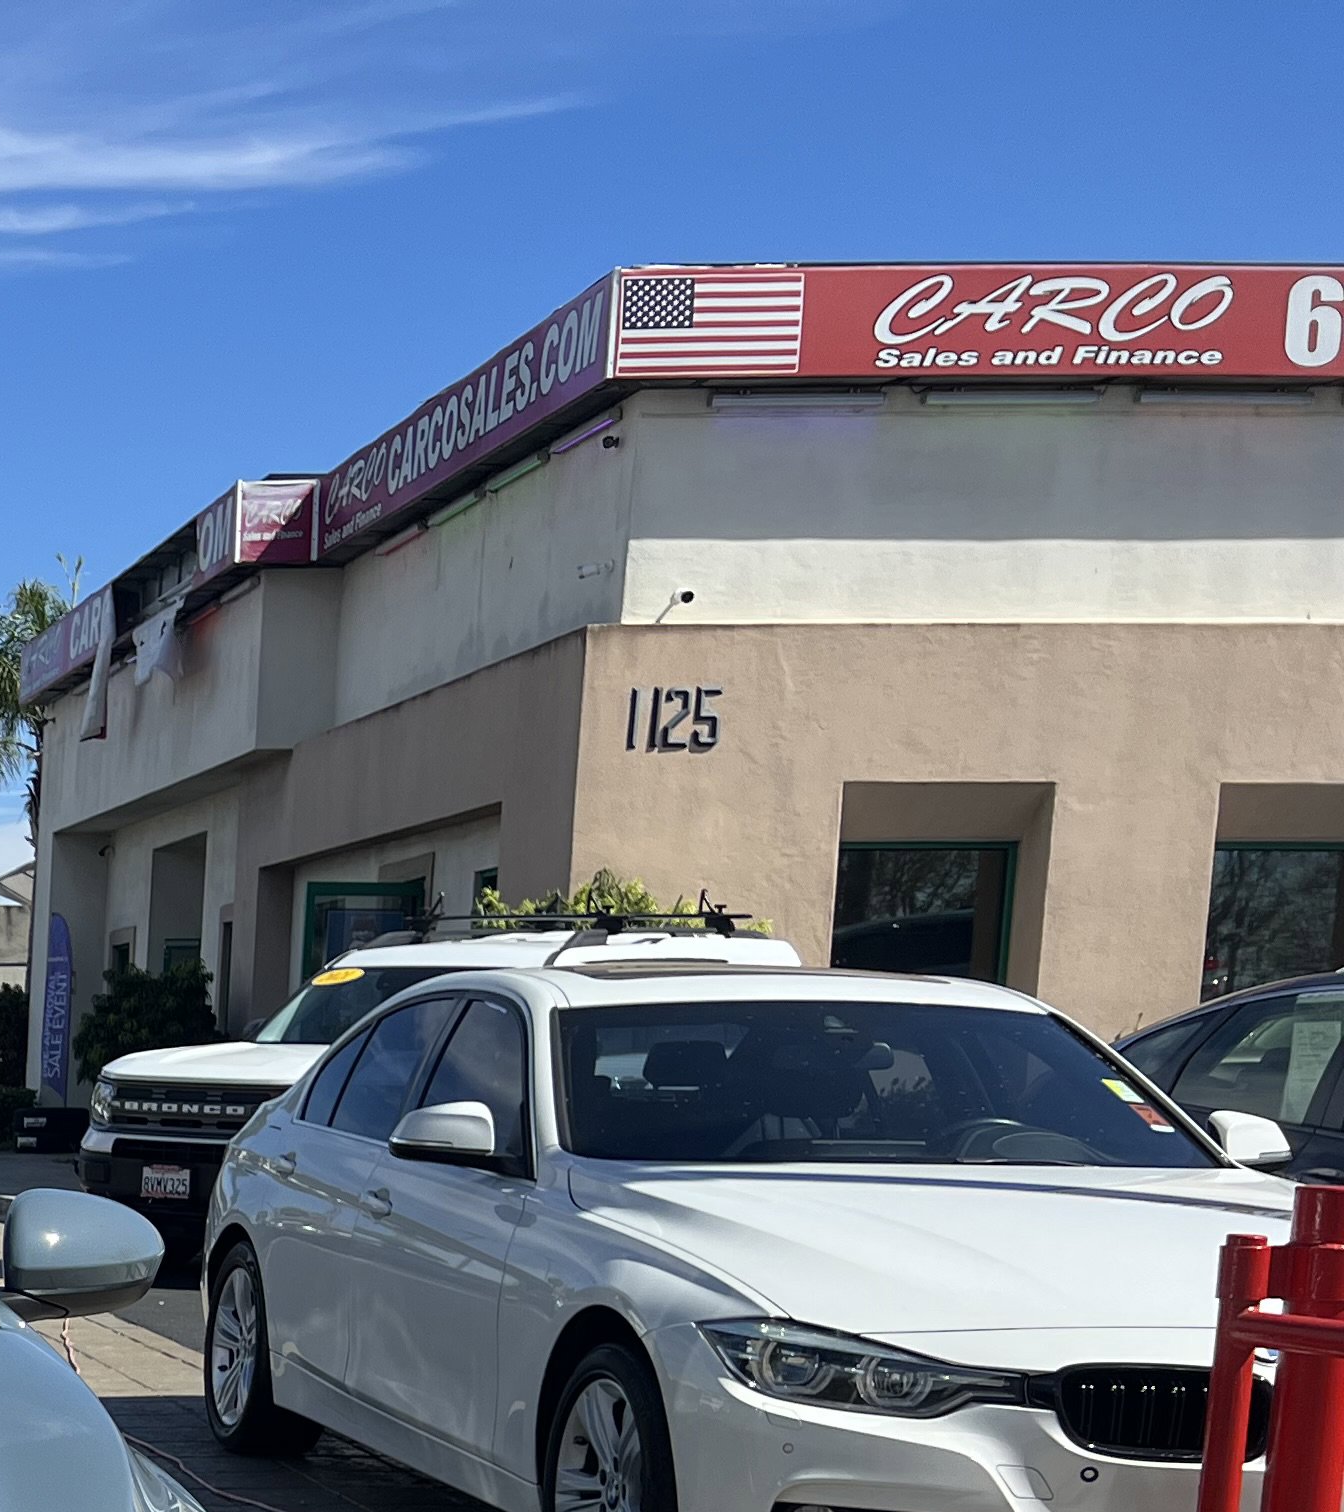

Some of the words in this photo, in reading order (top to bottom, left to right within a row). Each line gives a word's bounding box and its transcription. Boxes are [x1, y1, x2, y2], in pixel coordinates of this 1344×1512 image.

[874, 273, 1234, 344] CARCO
[875, 346, 980, 368] Sales
[991, 346, 1064, 367] and
[1072, 345, 1223, 367] Finance
[325, 441, 387, 525] CARCO
[387, 290, 604, 495] CARCOSALES.COM
[625, 686, 723, 753] 1125
[52, 972, 69, 1030] EVENT
[48, 1034, 63, 1079] SALE
[124, 1101, 245, 1115] BRONCO
